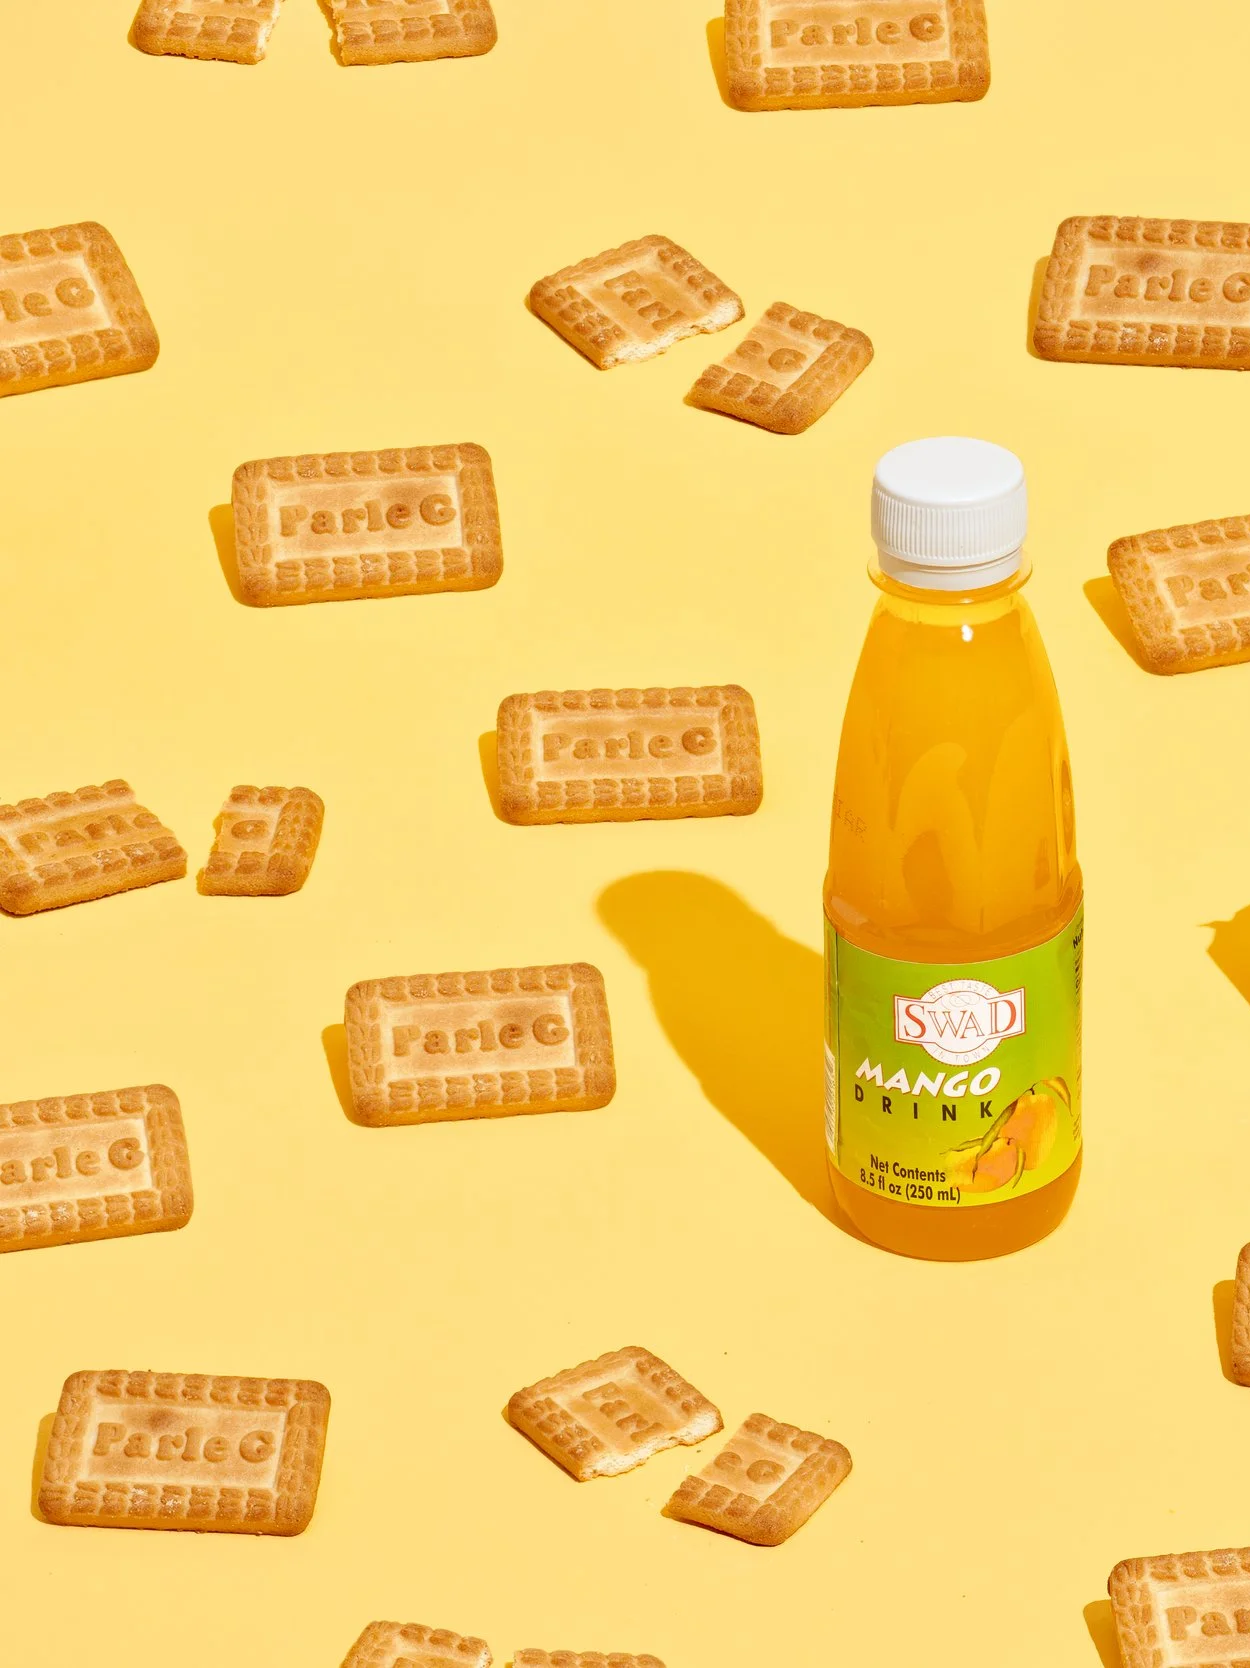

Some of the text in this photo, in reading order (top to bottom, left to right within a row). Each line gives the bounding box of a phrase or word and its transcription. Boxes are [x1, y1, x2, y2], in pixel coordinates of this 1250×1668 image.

[904, 1000, 1016, 1039] SWAD
[855, 1057, 1001, 1098] MANGO
[855, 1084, 993, 1121] DRINK
[860, 1168, 961, 1204] 8.5 fl oz (250 mL)
[870, 1154, 946, 1182] Net Contents
